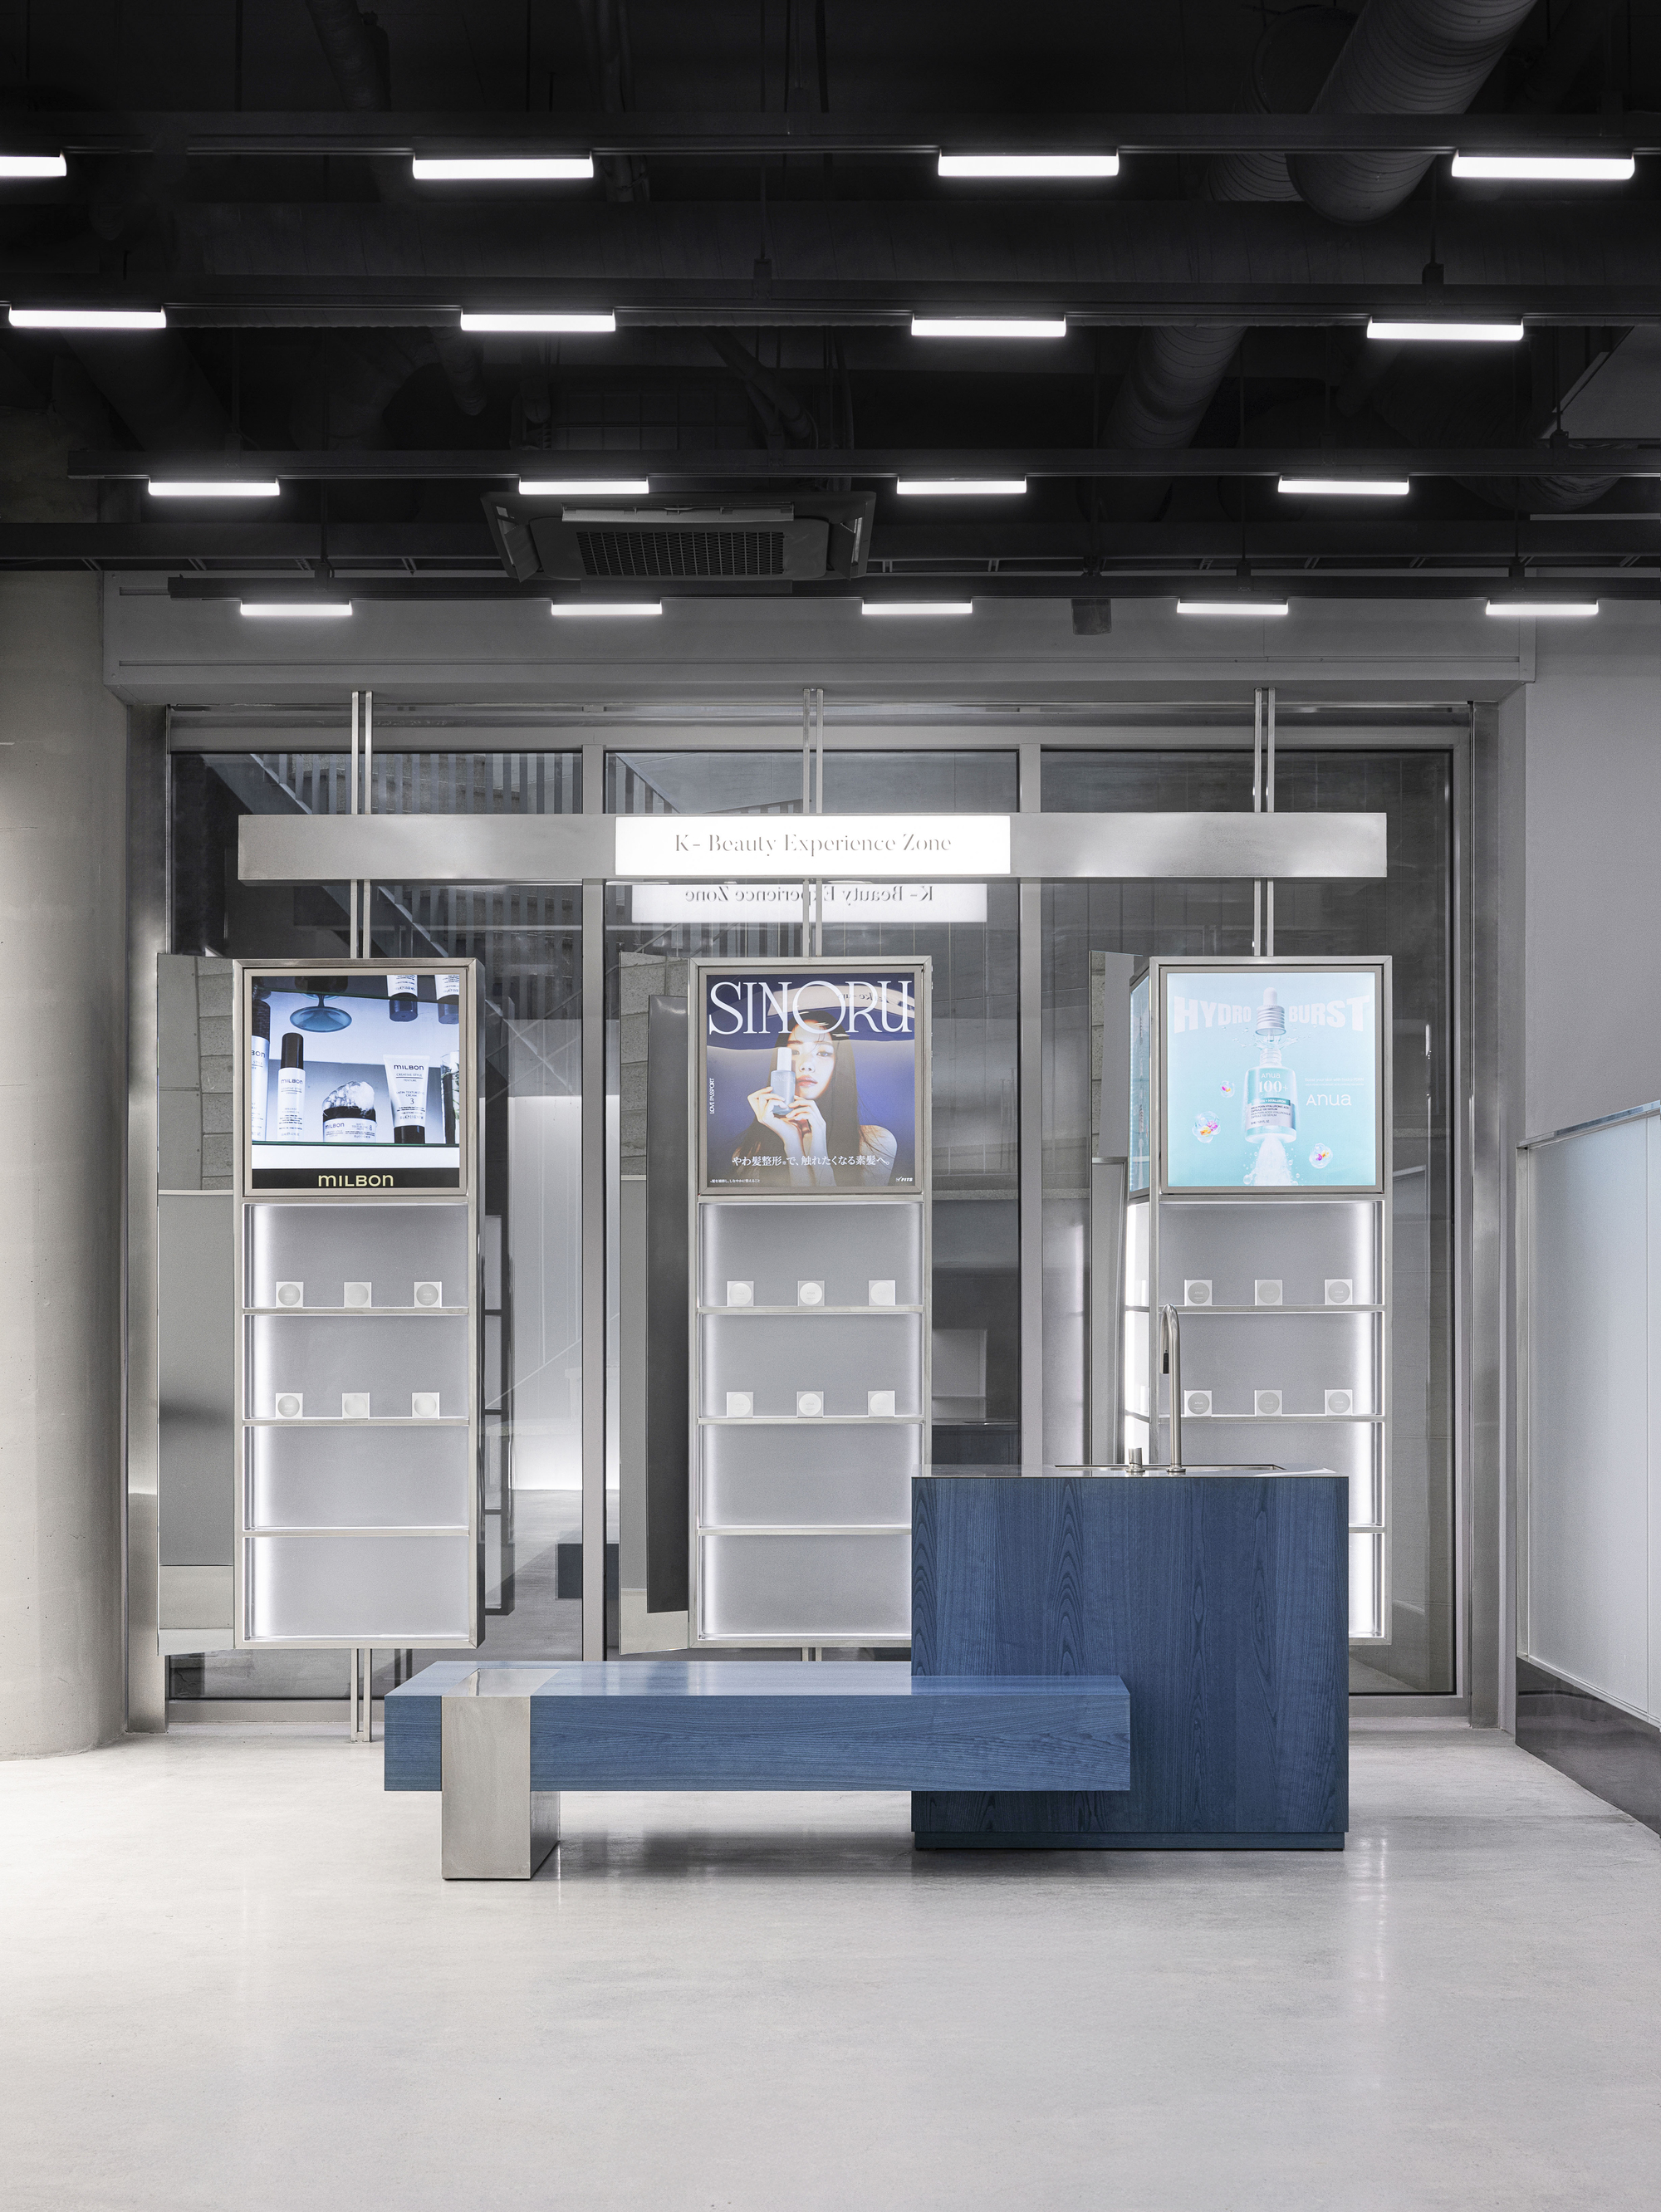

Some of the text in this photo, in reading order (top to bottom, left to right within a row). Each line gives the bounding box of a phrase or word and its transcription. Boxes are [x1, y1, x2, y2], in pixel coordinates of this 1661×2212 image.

[709, 834, 777, 857] Beauty
[785, 834, 896, 857] Experience
[903, 834, 952, 851] Zone
[709, 981, 913, 1035] SINORU
[1173, 996, 1252, 1034] HYDRO
[1288, 995, 1371, 1032] BURST
